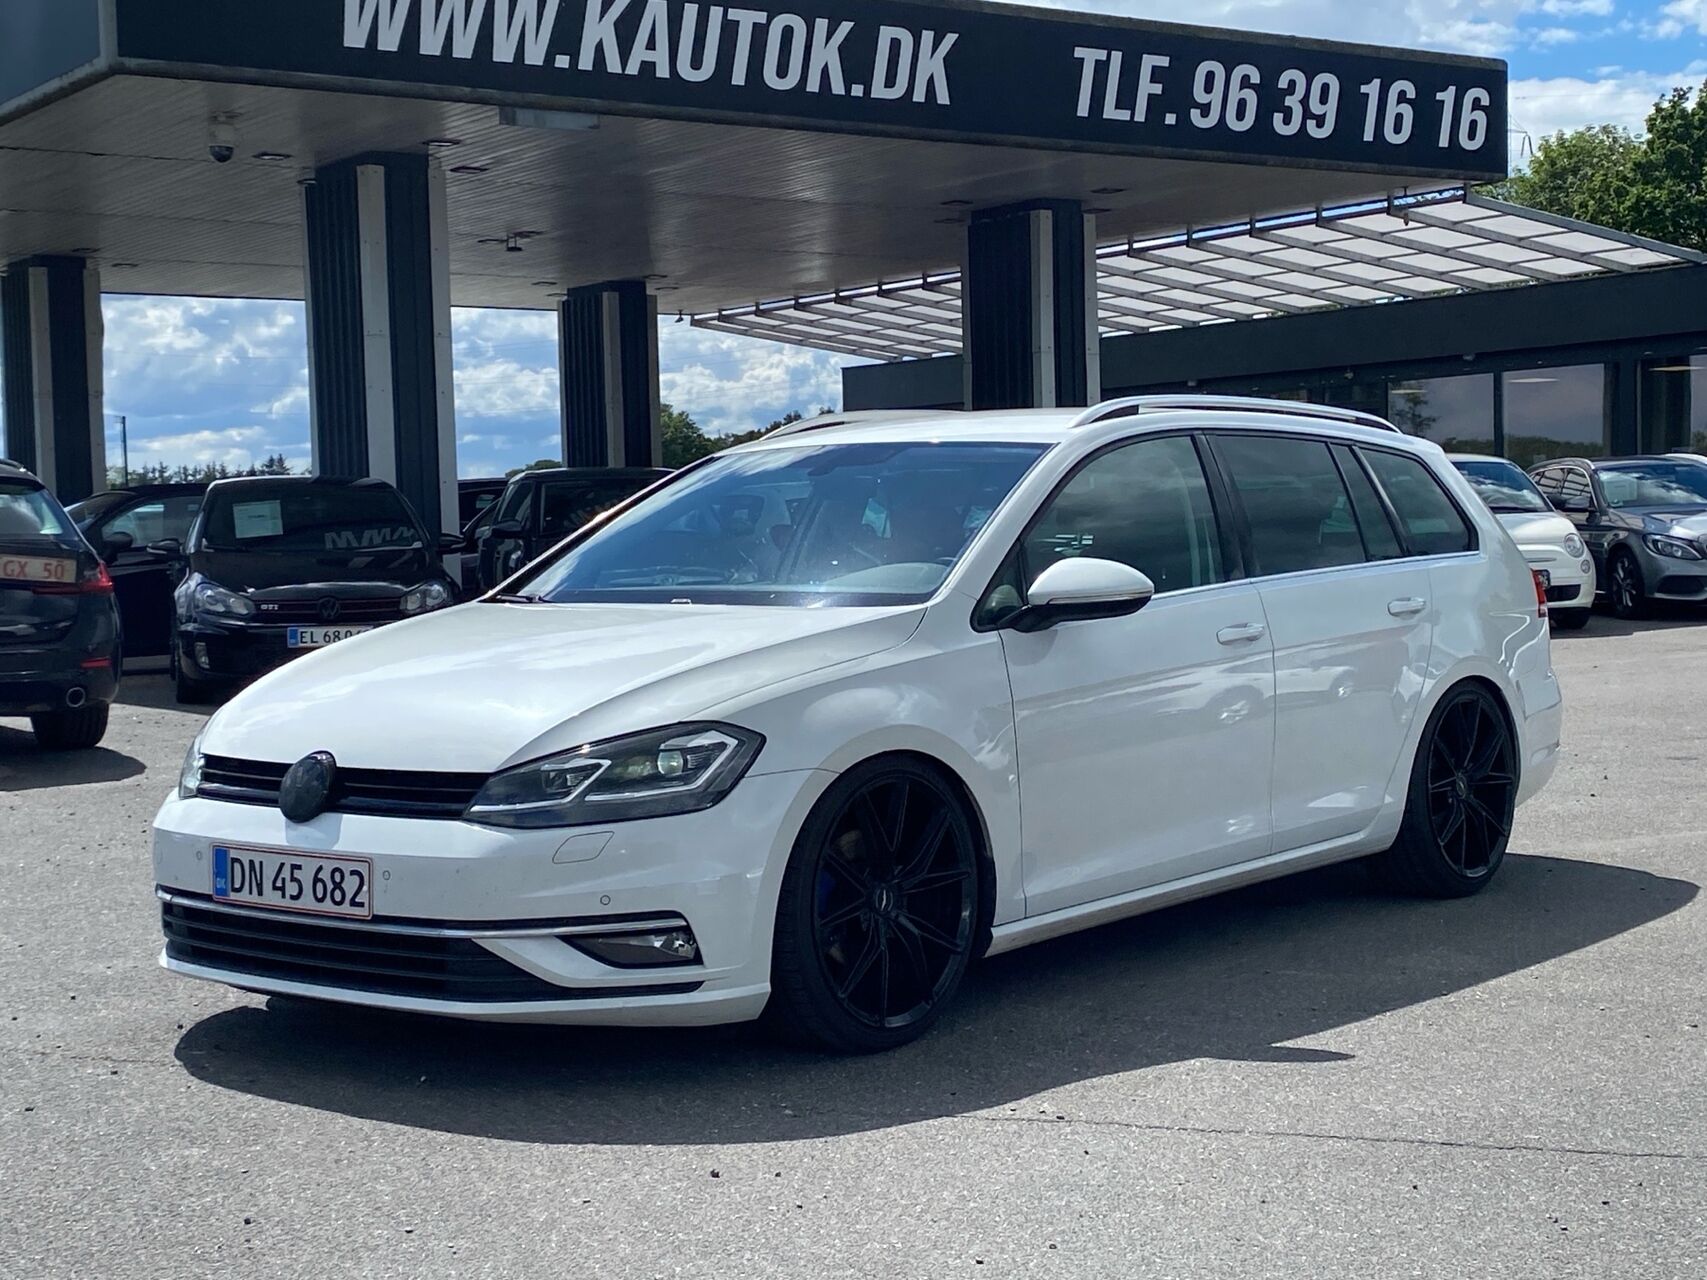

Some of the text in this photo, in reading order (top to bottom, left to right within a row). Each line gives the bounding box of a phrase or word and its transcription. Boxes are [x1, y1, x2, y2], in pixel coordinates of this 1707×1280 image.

[343, 0, 959, 105] WWW.KAUTOK.DK
[1073, 46, 1491, 151] TLF. 96 39 16 16
[300, 630, 318, 644] EL
[230, 857, 366, 908] DN 45 682
